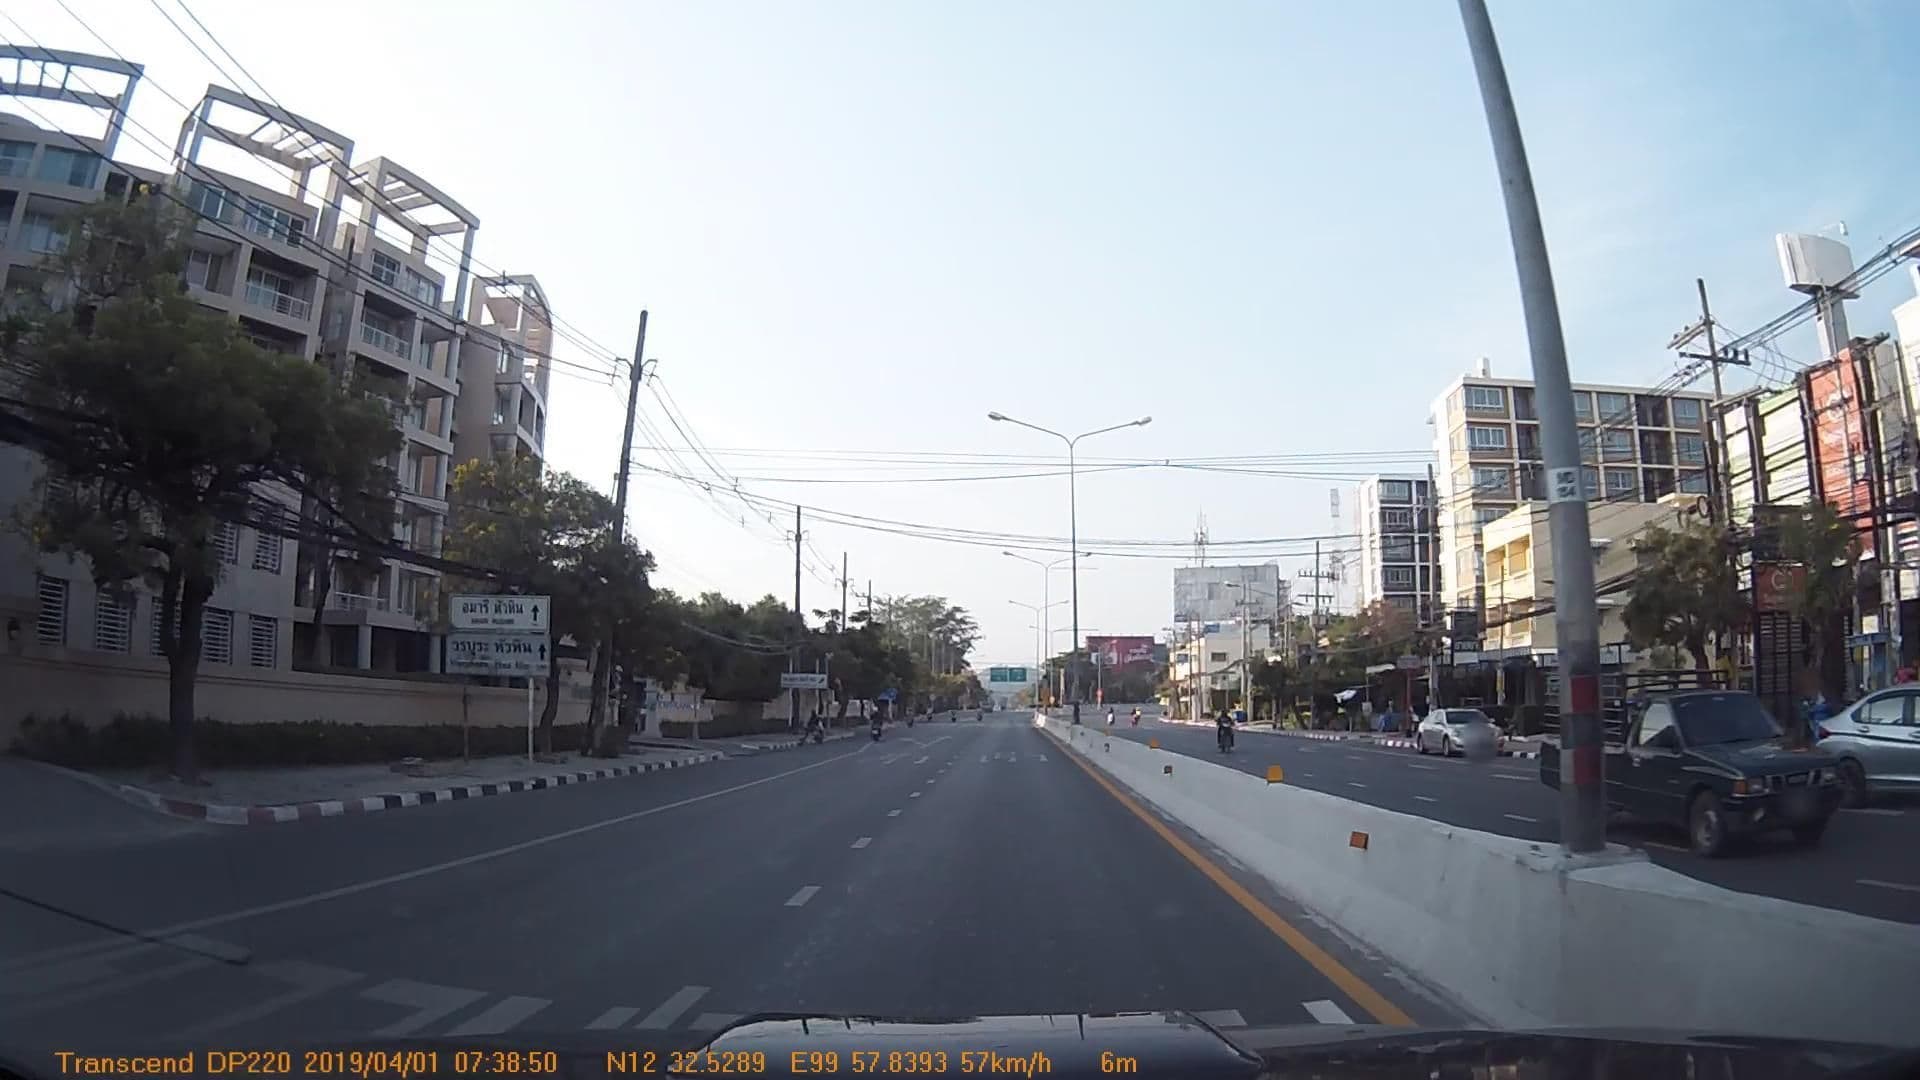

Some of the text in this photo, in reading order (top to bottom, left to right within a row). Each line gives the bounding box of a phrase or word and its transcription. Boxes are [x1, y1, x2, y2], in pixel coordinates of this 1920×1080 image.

[494, 599, 523, 614] หัวหิน
[495, 638, 532, 653] หัวหิน
